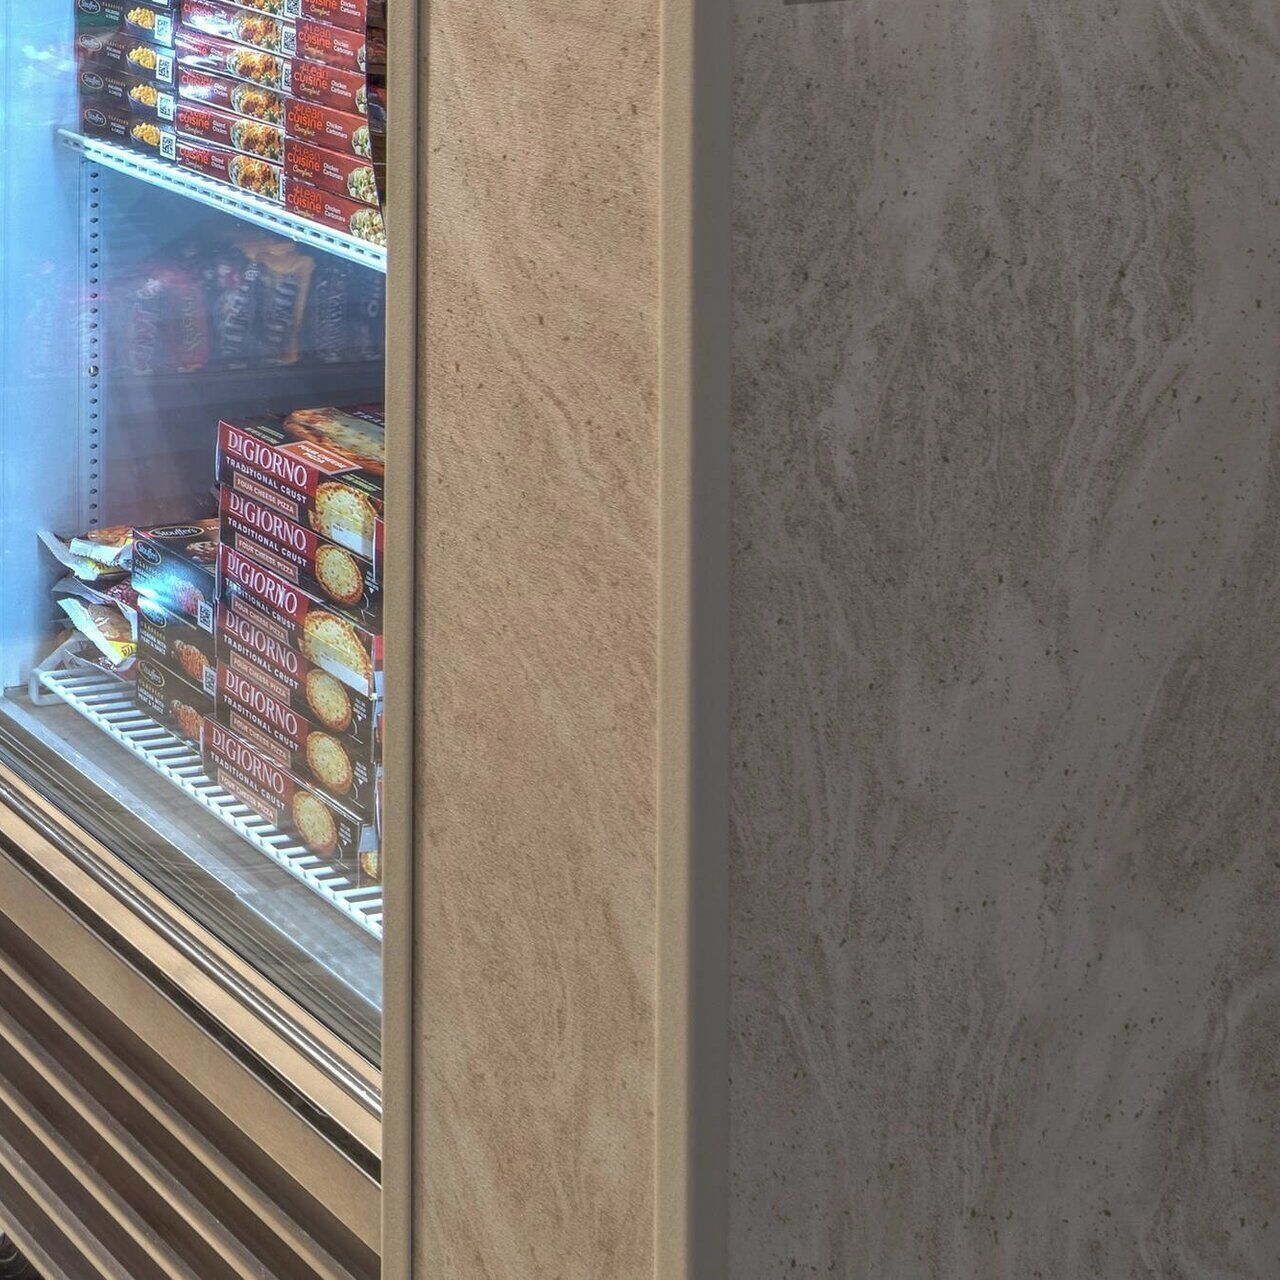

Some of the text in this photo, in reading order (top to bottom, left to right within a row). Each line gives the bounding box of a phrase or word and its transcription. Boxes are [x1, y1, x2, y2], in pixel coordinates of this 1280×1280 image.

[226, 457, 307, 504] TRADITIONAL CRUST
[228, 431, 308, 488] DIGIORNO
[228, 518, 308, 567] TRADITIONAL CRUST
[229, 493, 307, 551] DIGIORNO
[225, 577, 296, 631] TRADITIONAL CRUST
[227, 553, 298, 613] DIGIORNO
[224, 636, 299, 690] TRADITIONAL CRUST
[225, 610, 298, 673] DIGIORNO
[223, 695, 299, 751] TRADITIONAL CRUST
[225, 670, 298, 735] DIGIORNO
[211, 751, 285, 811] TRADITIONAL CRUST
[212, 728, 284, 795] DIGIORNO
